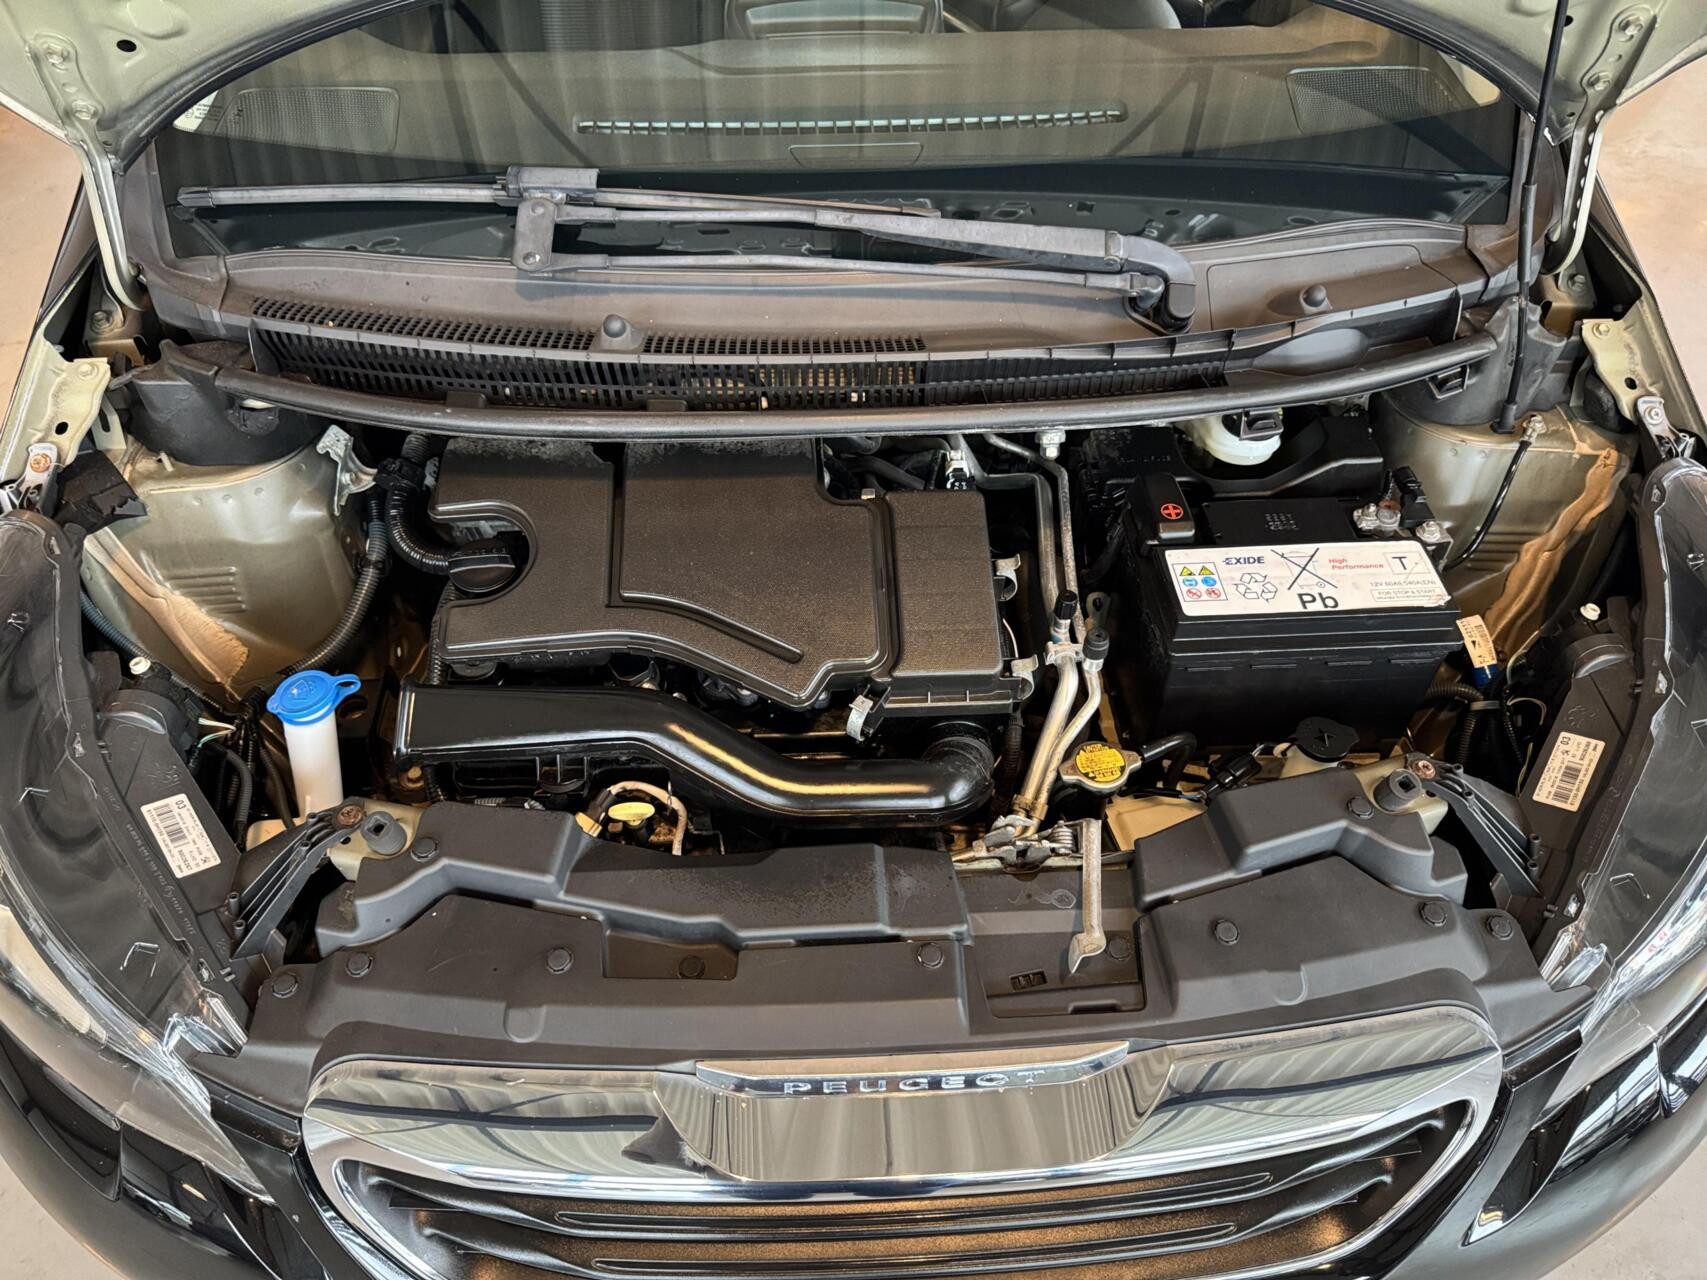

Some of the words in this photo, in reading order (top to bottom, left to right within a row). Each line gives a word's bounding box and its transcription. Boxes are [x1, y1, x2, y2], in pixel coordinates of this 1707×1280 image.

[1222, 556, 1265, 565] EXIDE
[1391, 556, 1407, 570] T
[1297, 592, 1339, 609] Pb
[175, 799, 187, 810] 03
[783, 1070, 1045, 1095] PEUGEOT
